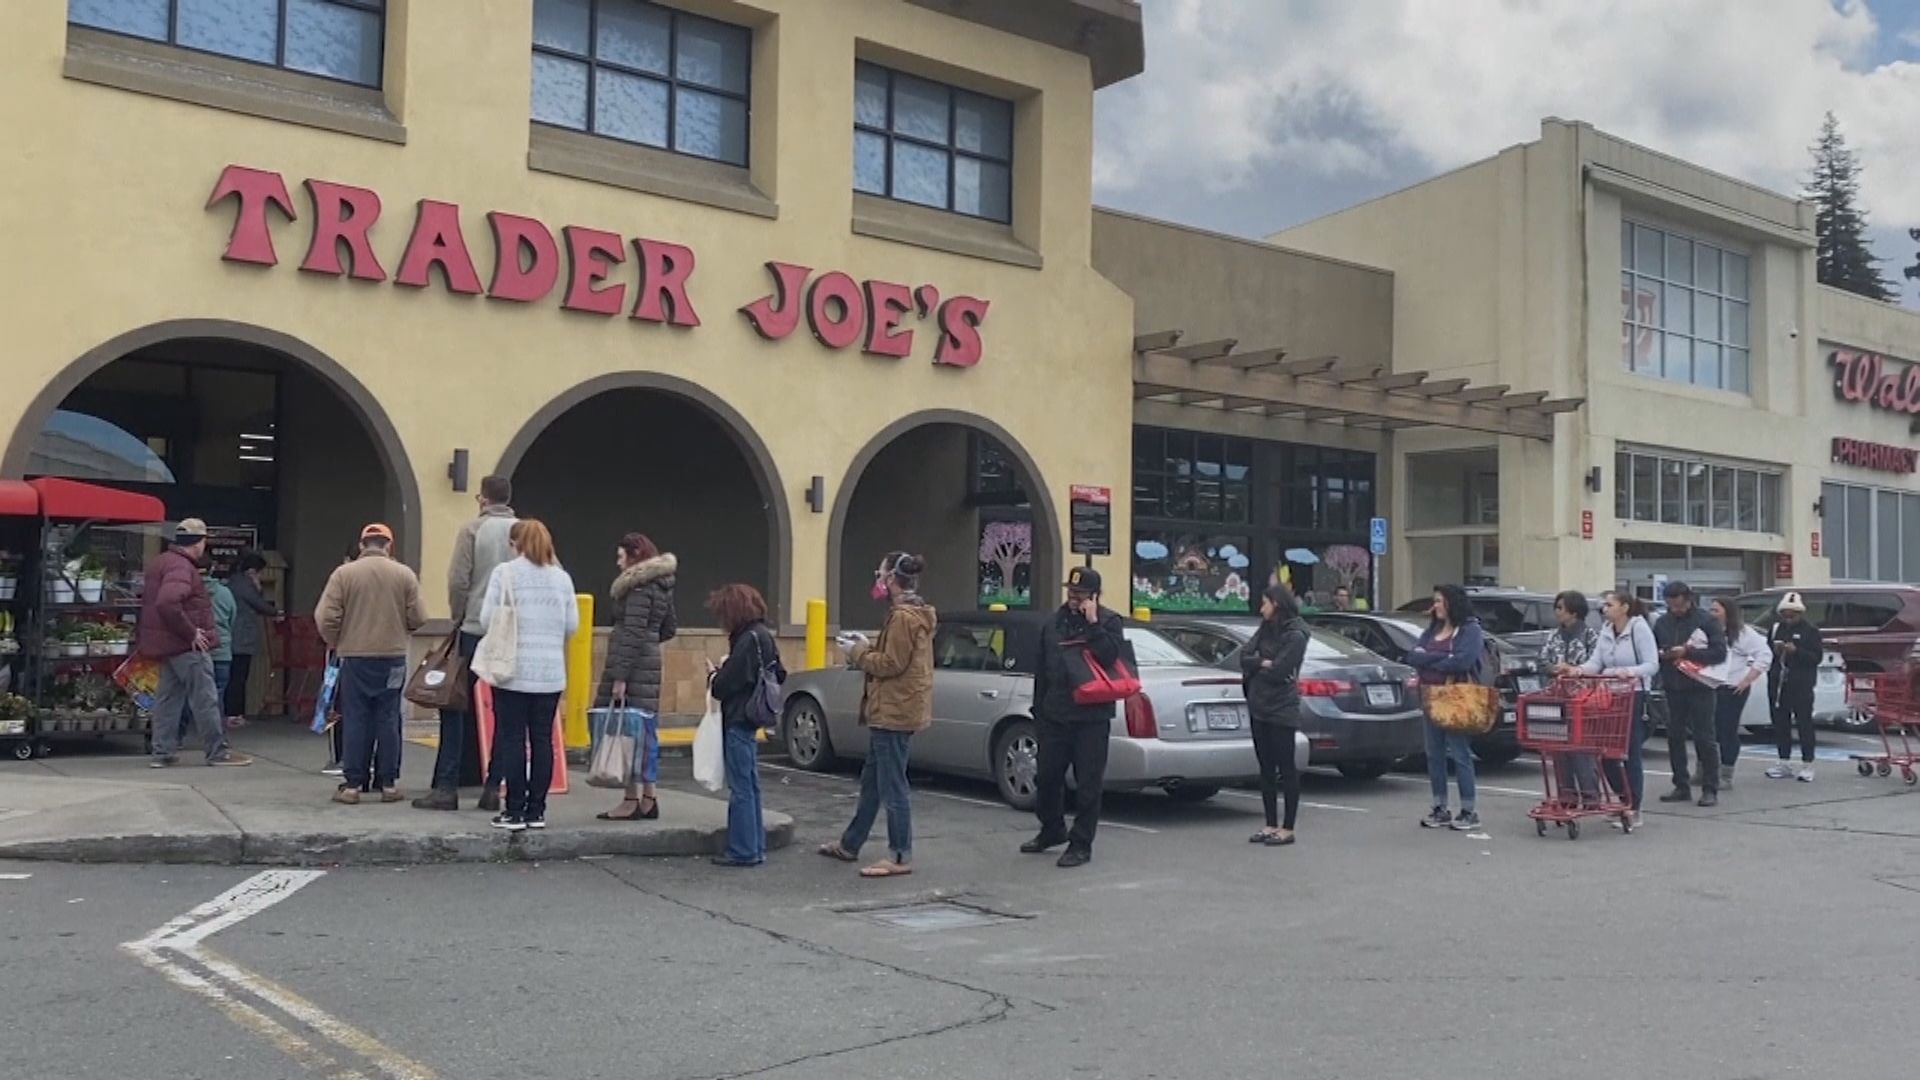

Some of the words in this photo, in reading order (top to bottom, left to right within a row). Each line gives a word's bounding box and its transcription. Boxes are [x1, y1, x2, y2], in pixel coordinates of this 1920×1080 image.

[205, 164, 701, 327] TRADER
[737, 261, 990, 368] JOE'S
[1832, 437, 1918, 473] PHARMACY
